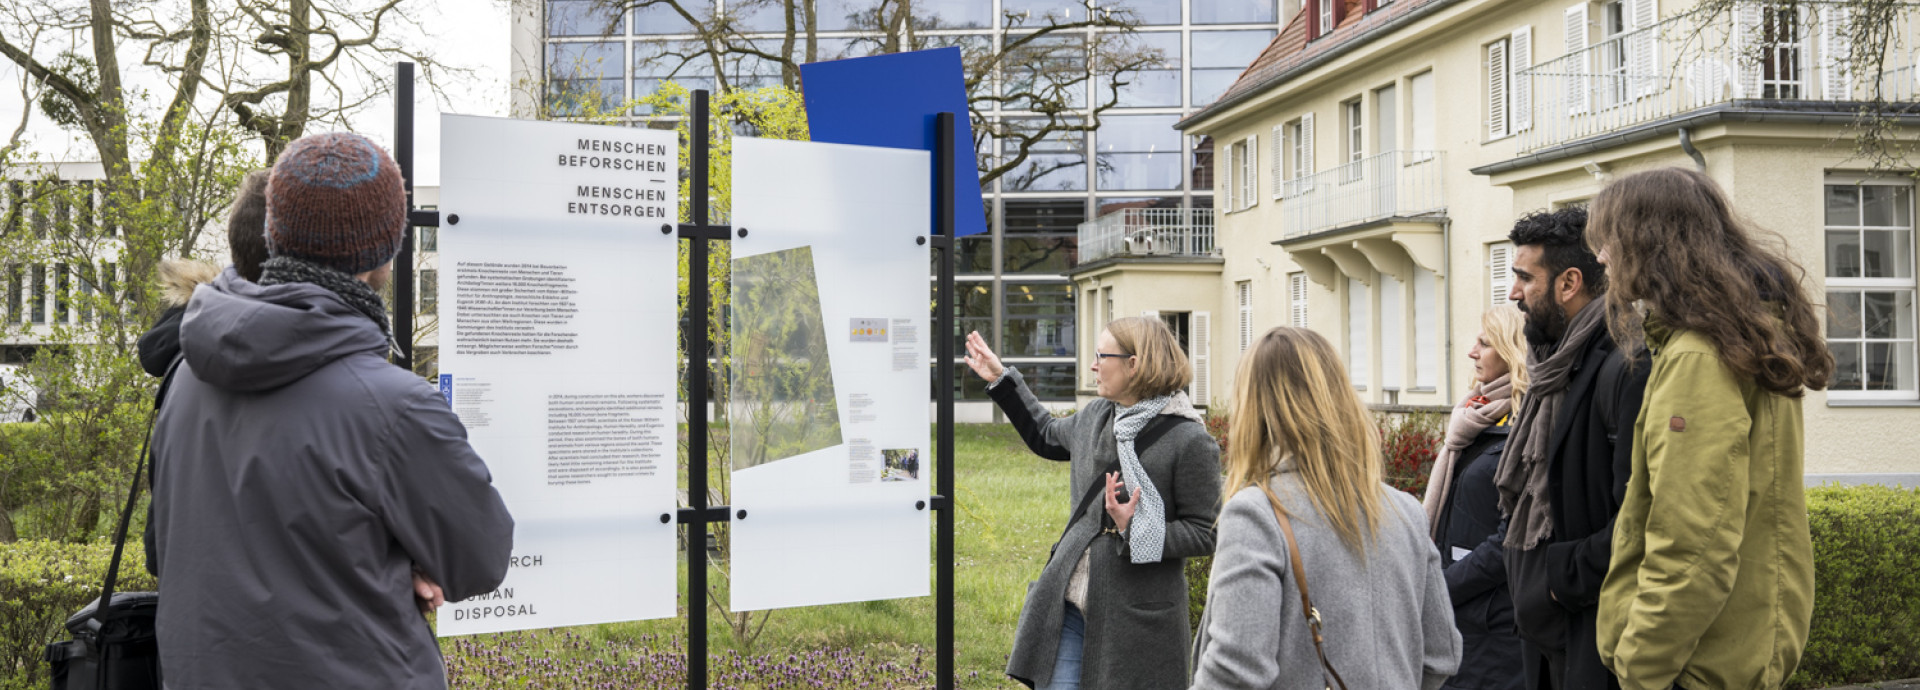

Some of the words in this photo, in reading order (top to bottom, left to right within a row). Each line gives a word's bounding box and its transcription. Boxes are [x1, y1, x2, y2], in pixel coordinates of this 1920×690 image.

[578, 138, 666, 156] MENSCHEN
[558, 154, 666, 172] BEFORSCHEN
[578, 186, 666, 201] MENSCHEN
[568, 202, 666, 218] ENTSORGEN
[456, 604, 537, 620] DISPOSAL
